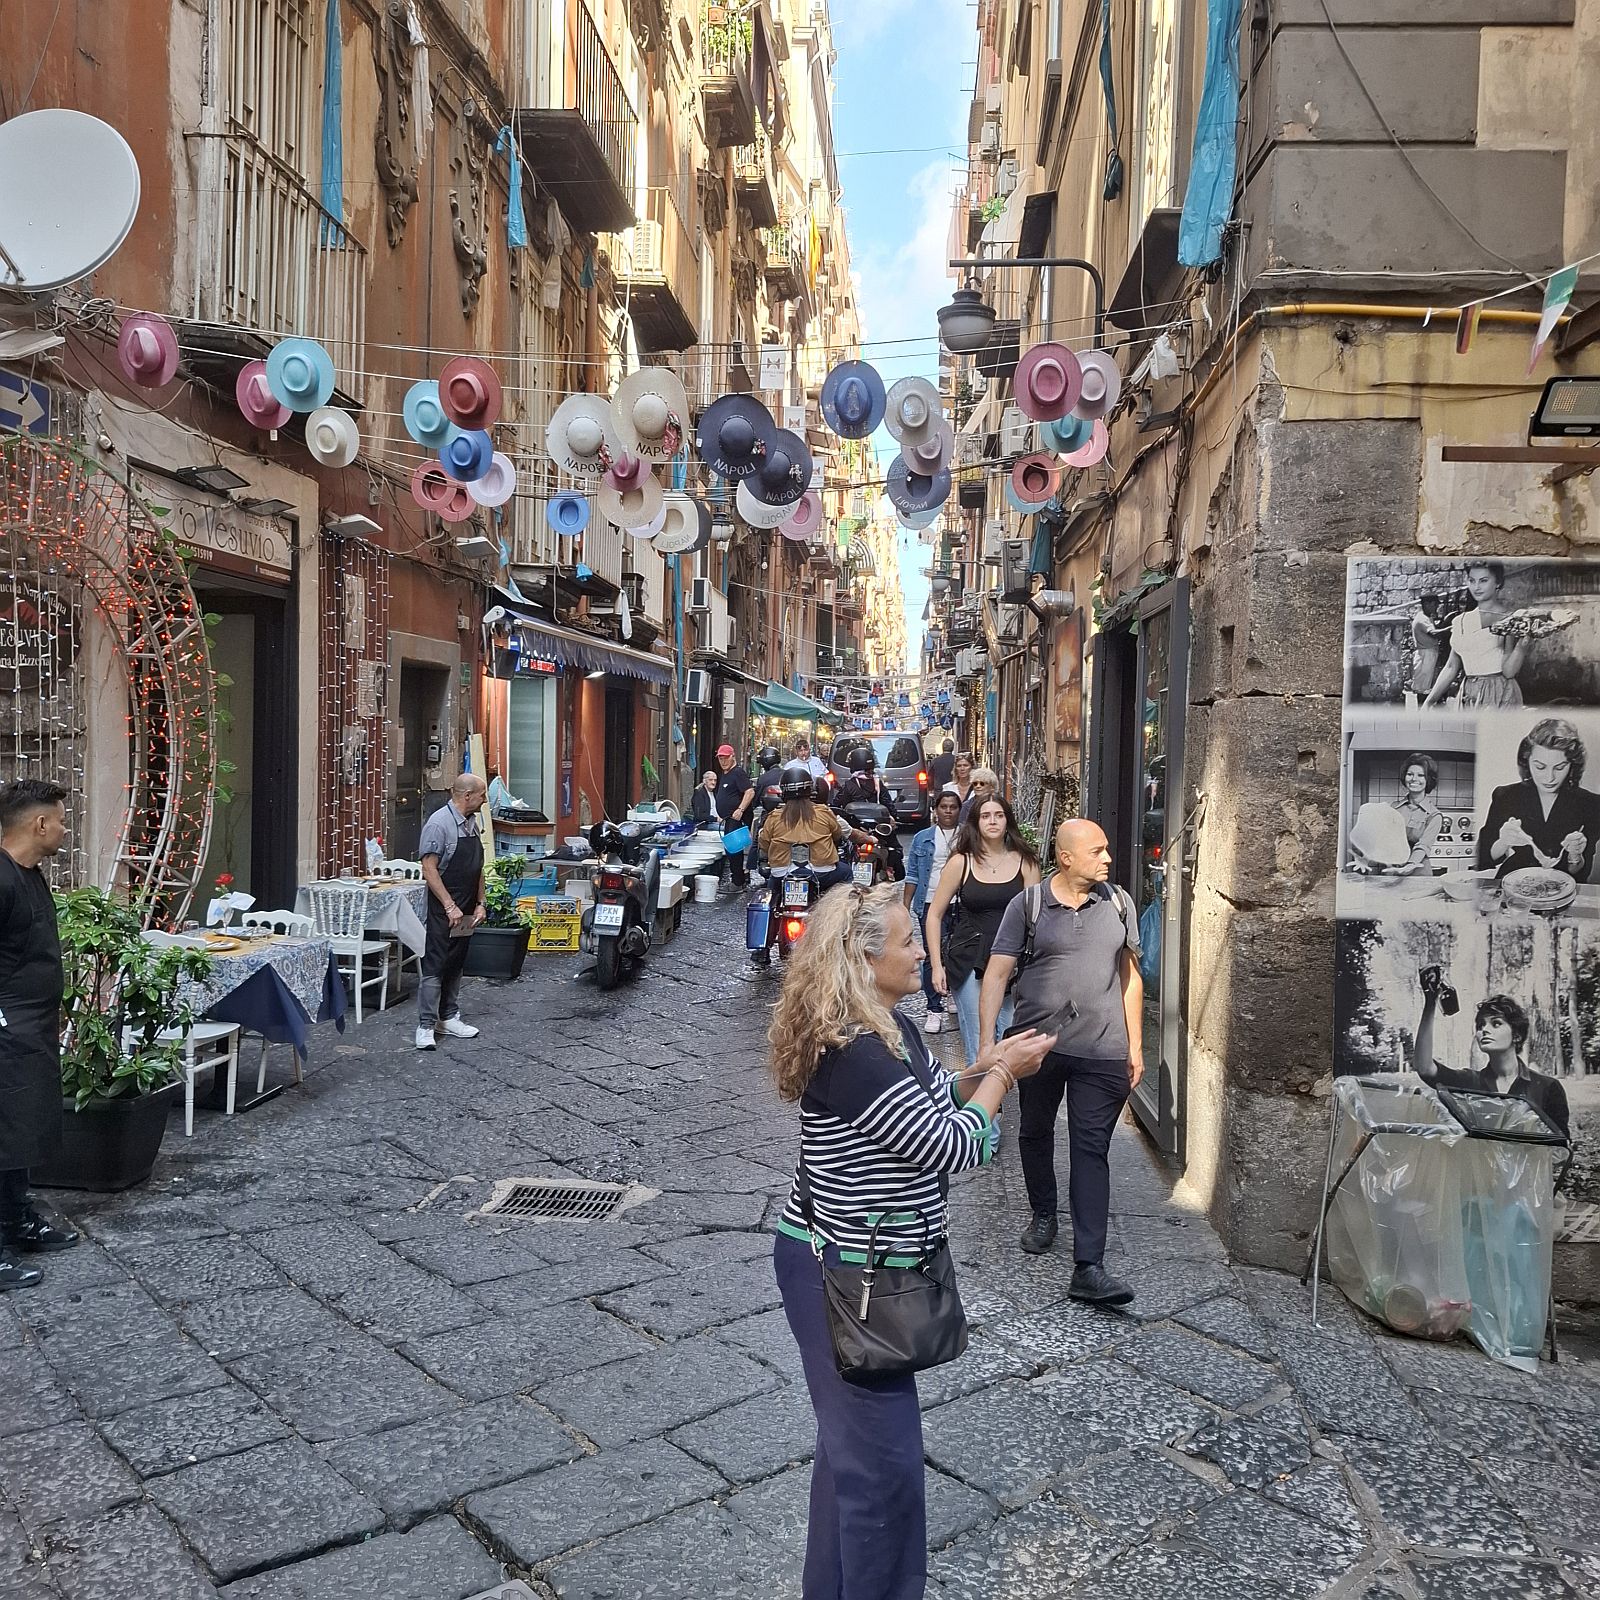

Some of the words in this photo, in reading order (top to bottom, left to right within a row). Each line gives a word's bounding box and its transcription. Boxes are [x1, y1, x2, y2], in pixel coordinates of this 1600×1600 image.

[714, 458, 756, 476] NAPOLI
[765, 486, 802, 502] NAPOLI
[602, 906, 618, 915] PKN
